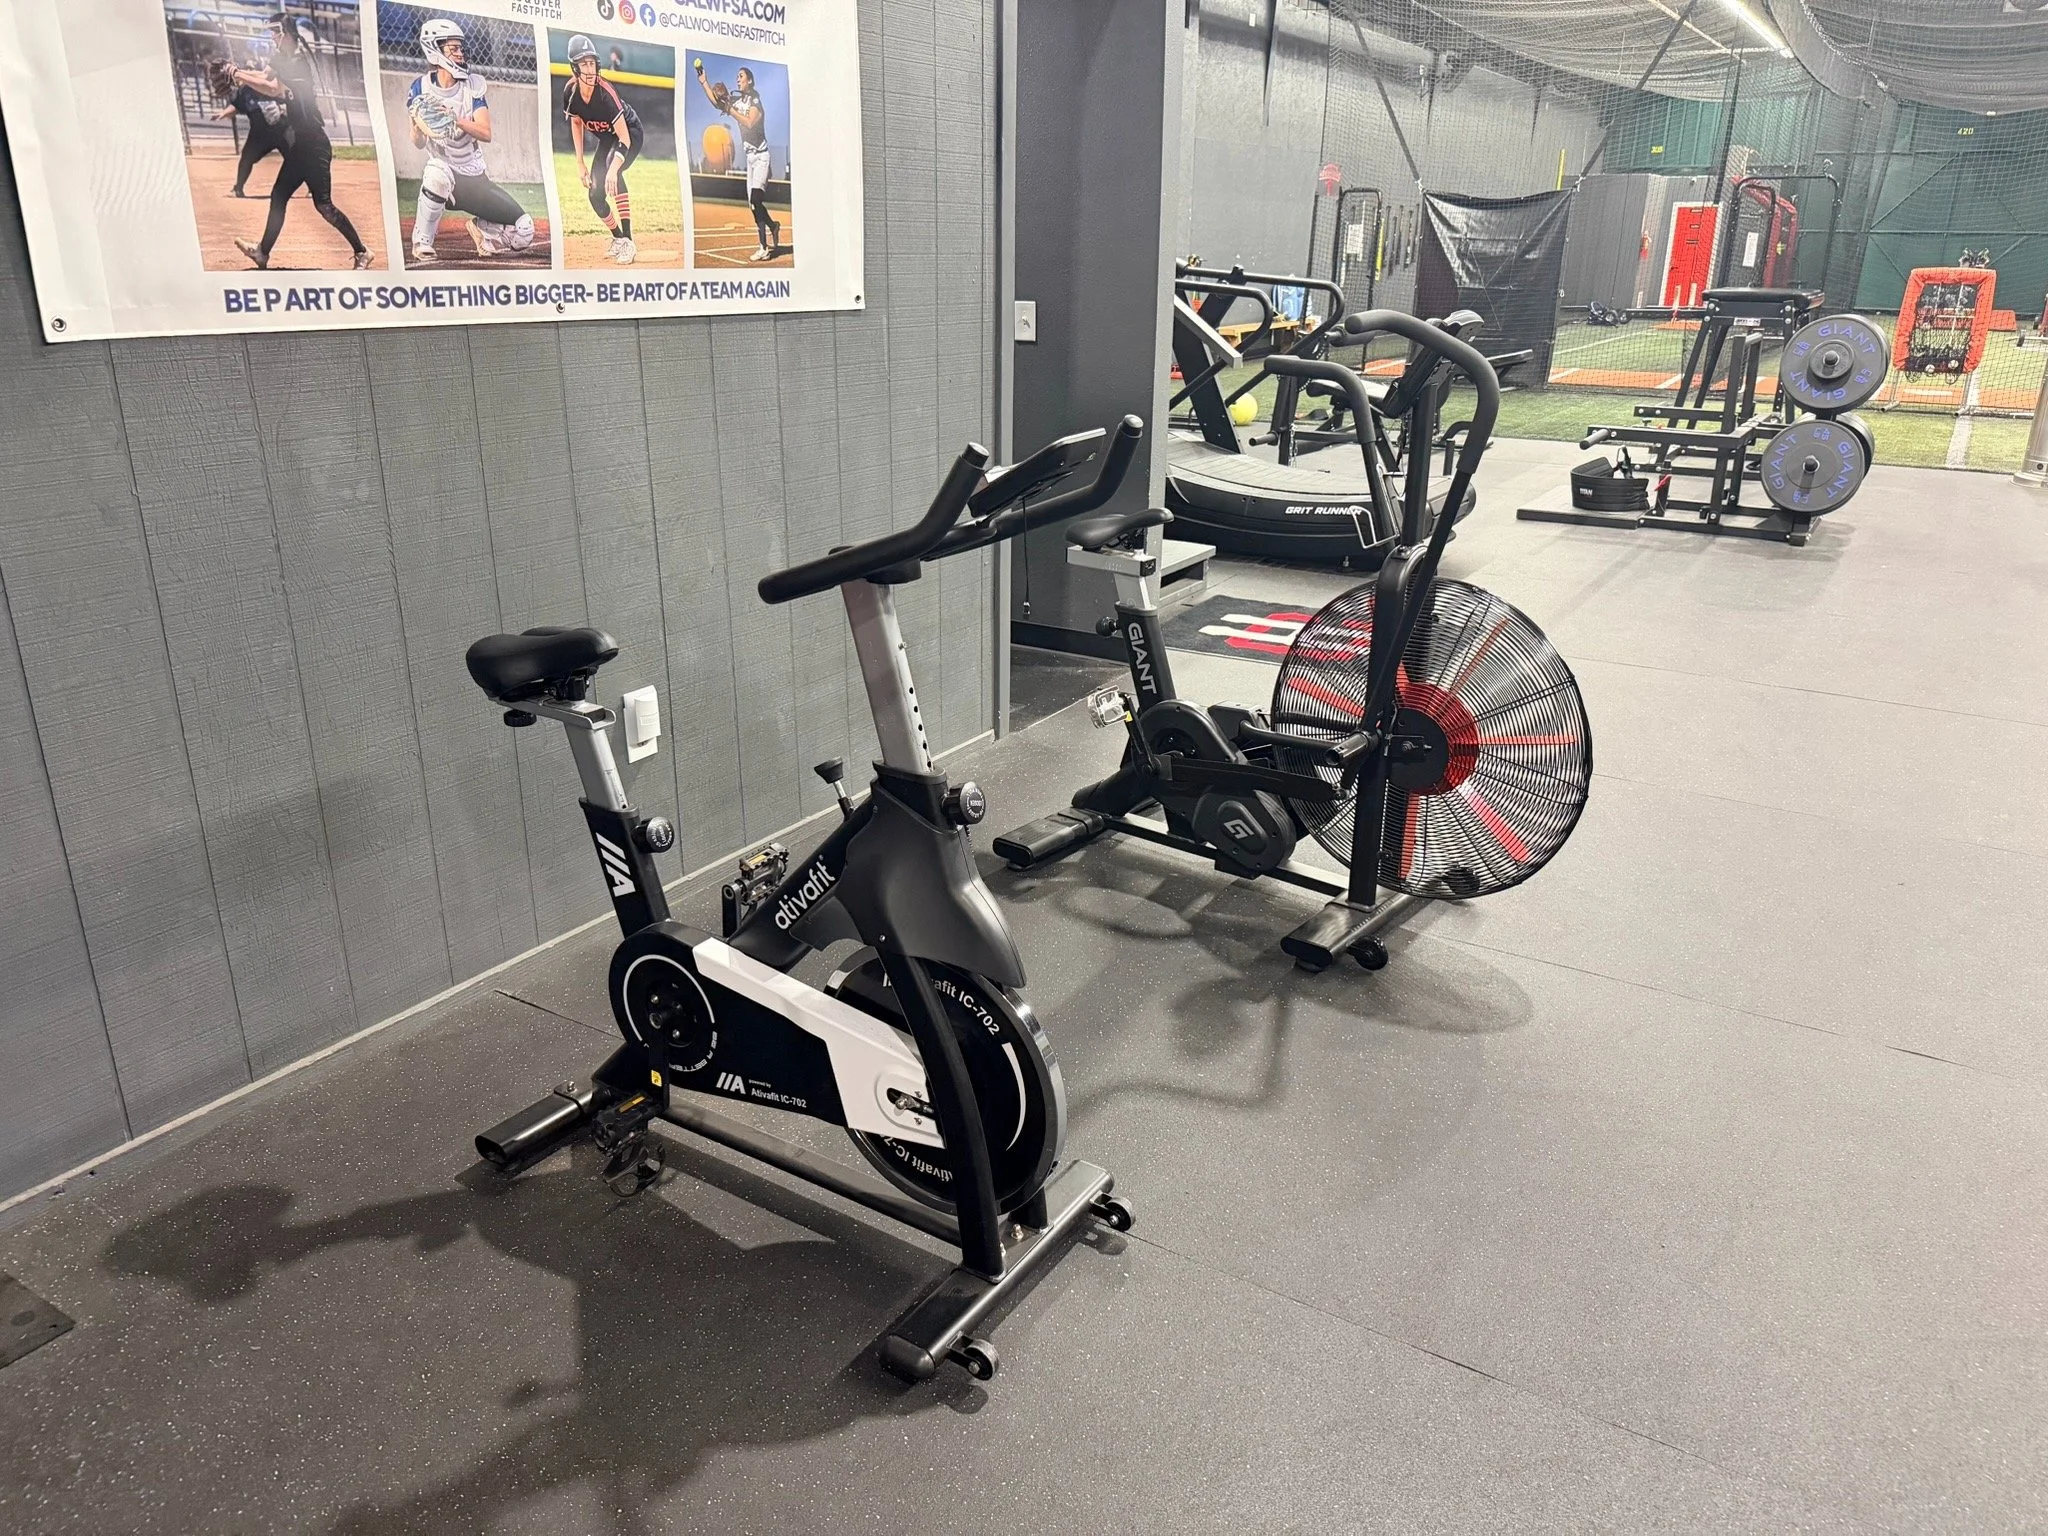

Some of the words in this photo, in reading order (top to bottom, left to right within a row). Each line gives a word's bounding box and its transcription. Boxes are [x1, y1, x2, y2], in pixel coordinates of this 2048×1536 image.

[511, 2, 562, 20] FASTPITCH
[674, 0, 786, 25] LWFSA.COM
[659, 12, 786, 46] @CALWOMENSFASTPITCH
[224, 288, 261, 313] BE
[338, 286, 373, 310] OF
[376, 284, 512, 309] SOMETHING
[515, 283, 593, 305] BIGGER-
[597, 283, 621, 303] BE
[624, 282, 665, 302] PART
[666, 282, 688, 300] OF
[689, 282, 703, 300] A
[702, 281, 744, 299] TEAM
[745, 280, 790, 299] AGAIN
[1818, 324, 1876, 354] GIANT
[1789, 370, 1848, 400] GIANT
[1769, 433, 1798, 489] GIANT
[1825, 441, 1855, 499] GIANT
[1285, 506, 1313, 515] GRIT
[1314, 506, 1362, 516] RUNNER
[1128, 622, 1157, 694] GIANT
[775, 860, 836, 930] ativafit
[958, 990, 1000, 1036] IC-702
[751, 1087, 780, 1102] Ativafit
[780, 1094, 807, 1109] IC-702
[881, 1133, 911, 1162] IC-7
[911, 1155, 953, 1182] tivafit
